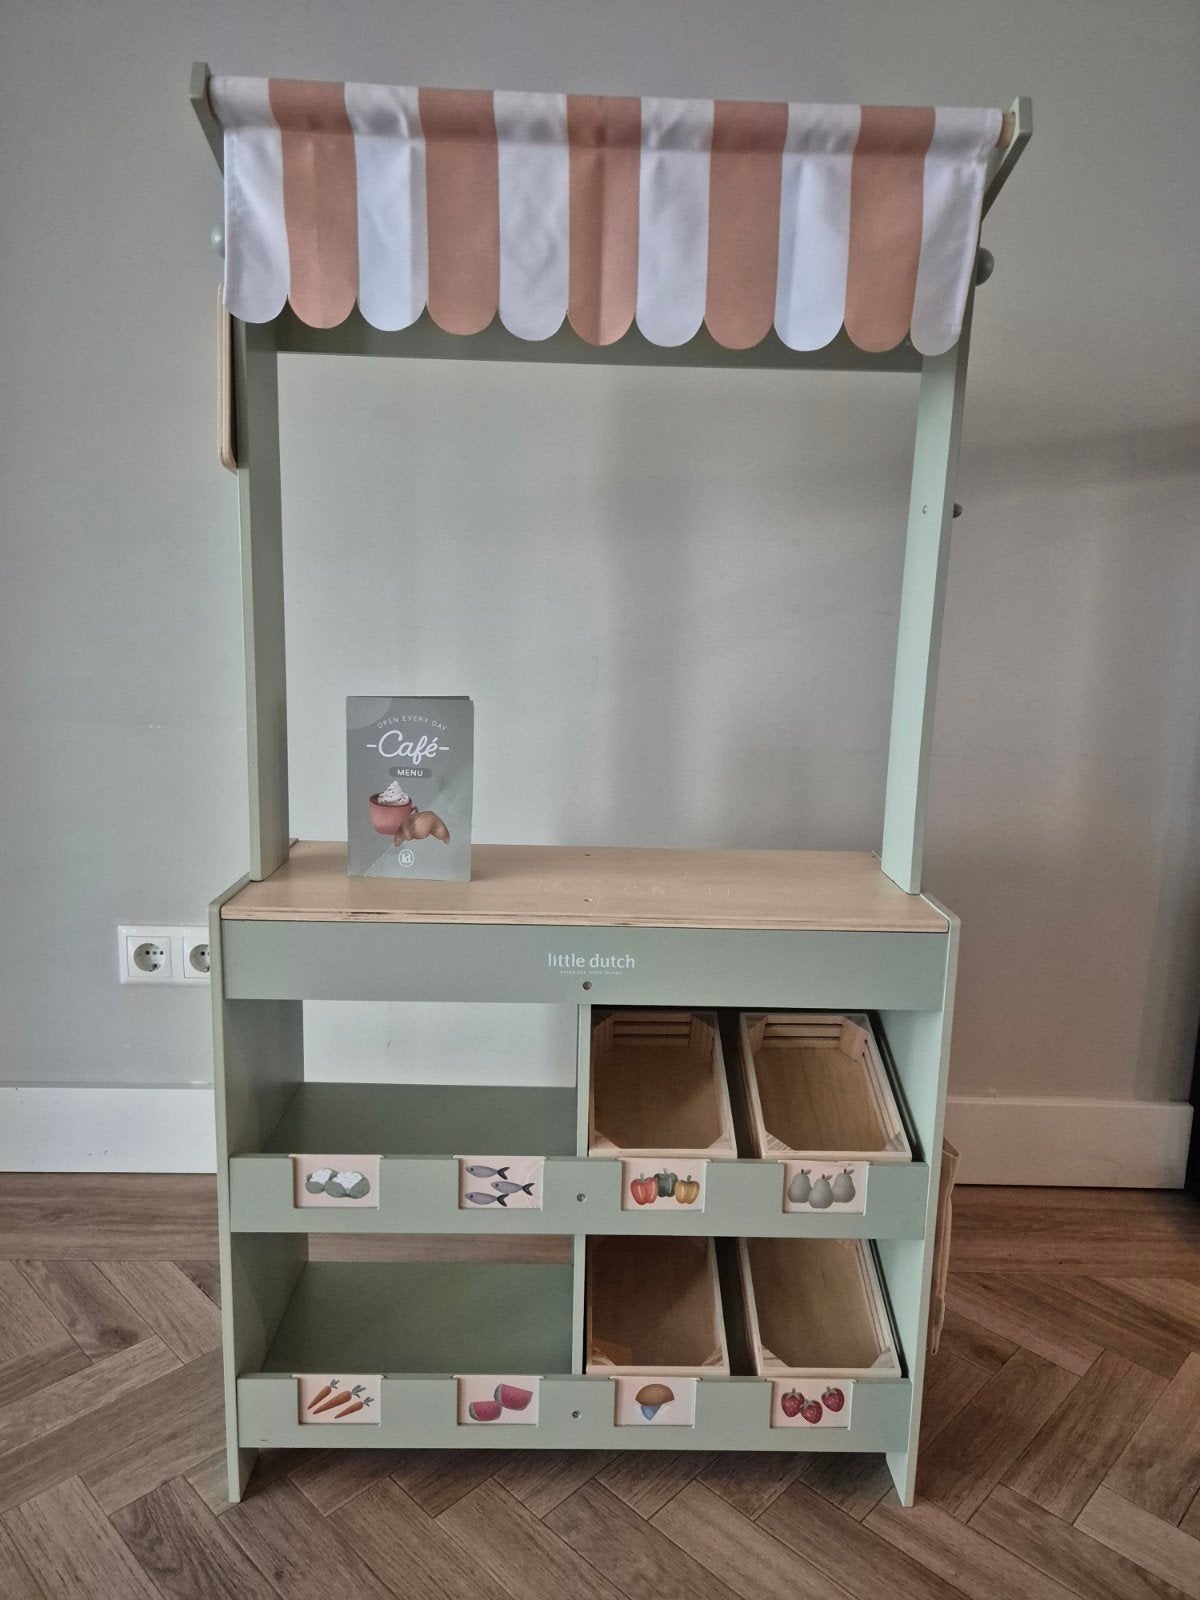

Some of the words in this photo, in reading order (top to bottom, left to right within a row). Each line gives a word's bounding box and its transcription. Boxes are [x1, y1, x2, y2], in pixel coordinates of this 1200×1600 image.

[377, 717, 399, 729] OPEN
[431, 720, 448, 731] DAY
[397, 769, 424, 777] MENU
[548, 953, 586, 968] little
[589, 953, 635, 969] dutch
